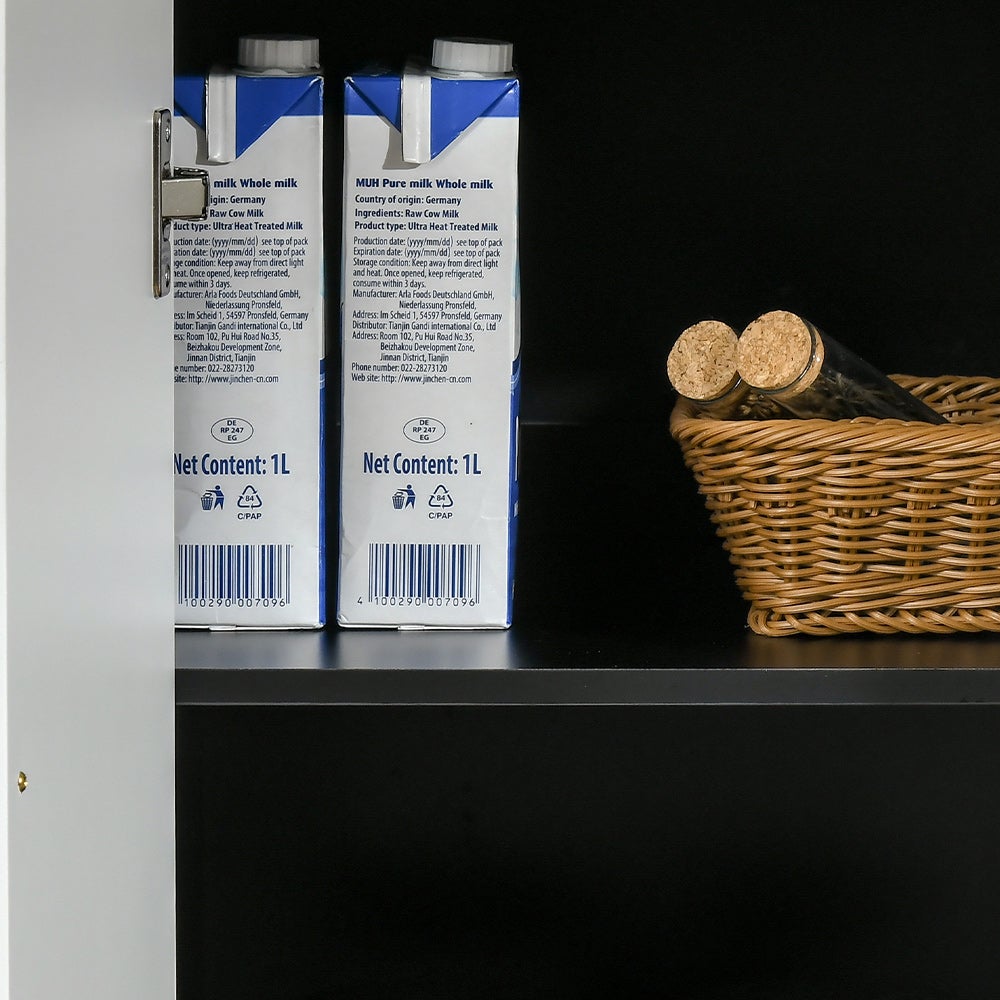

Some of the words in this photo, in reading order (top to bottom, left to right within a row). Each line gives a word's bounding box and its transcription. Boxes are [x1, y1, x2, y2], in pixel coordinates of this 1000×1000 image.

[214, 178, 237, 188] milk
[240, 178, 271, 188] Whole
[275, 178, 298, 188] milk
[356, 178, 380, 187] MUH
[383, 179, 406, 188] Pure
[410, 179, 433, 188] milk
[436, 179, 467, 188] Whole
[470, 179, 494, 189] milk
[230, 195, 266, 206] Germany
[355, 195, 387, 206] Country
[388, 195, 396, 203] of
[397, 195, 424, 206] origin:
[426, 196, 462, 206] Germany
[210, 209, 227, 217] Raw
[229, 209, 245, 217] Cow
[247, 209, 264, 217] Milk
[355, 209, 404, 218] Ingredients:
[405, 209, 422, 217] Raw
[424, 210, 440, 218] Cow
[442, 210, 459, 218] Milk
[191, 223, 211, 232] type:
[213, 222, 233, 230] Ultra
[235, 222, 253, 230] Heat
[254, 222, 285, 230] Treated
[286, 222, 303, 230] Milk
[355, 222, 384, 230] Product
[386, 222, 406, 232] type:
[408, 222, 428, 230] Ultra
[430, 223, 448, 231] Heat
[450, 223, 480, 231] Treated
[481, 223, 498, 231] Milk
[354, 237, 387, 246] Production
[389, 237, 406, 245] date:
[407, 237, 454, 247] (yyyy/mm/dd)
[468, 239, 480, 248] top
[481, 238, 488, 246] of
[489, 239, 503, 248] pack
[353, 290, 397, 299] Manufacturer:
[399, 290, 411, 298] Arla
[413, 290, 431, 298] Foods
[433, 290, 472, 299] Deutschland
[473, 291, 495, 300] GmbH,
[353, 311, 379, 319] Address:
[380, 311, 388, 319] Im
[390, 311, 411, 319] Scheid
[412, 312, 419, 320] 1,
[420, 312, 440, 320] 54597
[441, 311, 473, 321] Pronsfeld,
[474, 312, 502, 322] Germany
[352, 363, 372, 371] Phone
[373, 364, 400, 372] number:
[401, 364, 448, 373] 022-28273120
[174, 453, 198, 475] Net
[202, 453, 266, 475] Content:
[271, 453, 290, 474] 1L
[363, 452, 390, 474] Net
[393, 453, 458, 474] Content:
[463, 453, 481, 474] 1L
[184, 599, 231, 608] 100290
[238, 599, 286, 608] 007096
[357, 596, 363, 604] 4
[374, 596, 421, 606] 100290
[428, 597, 475, 607] 007096
